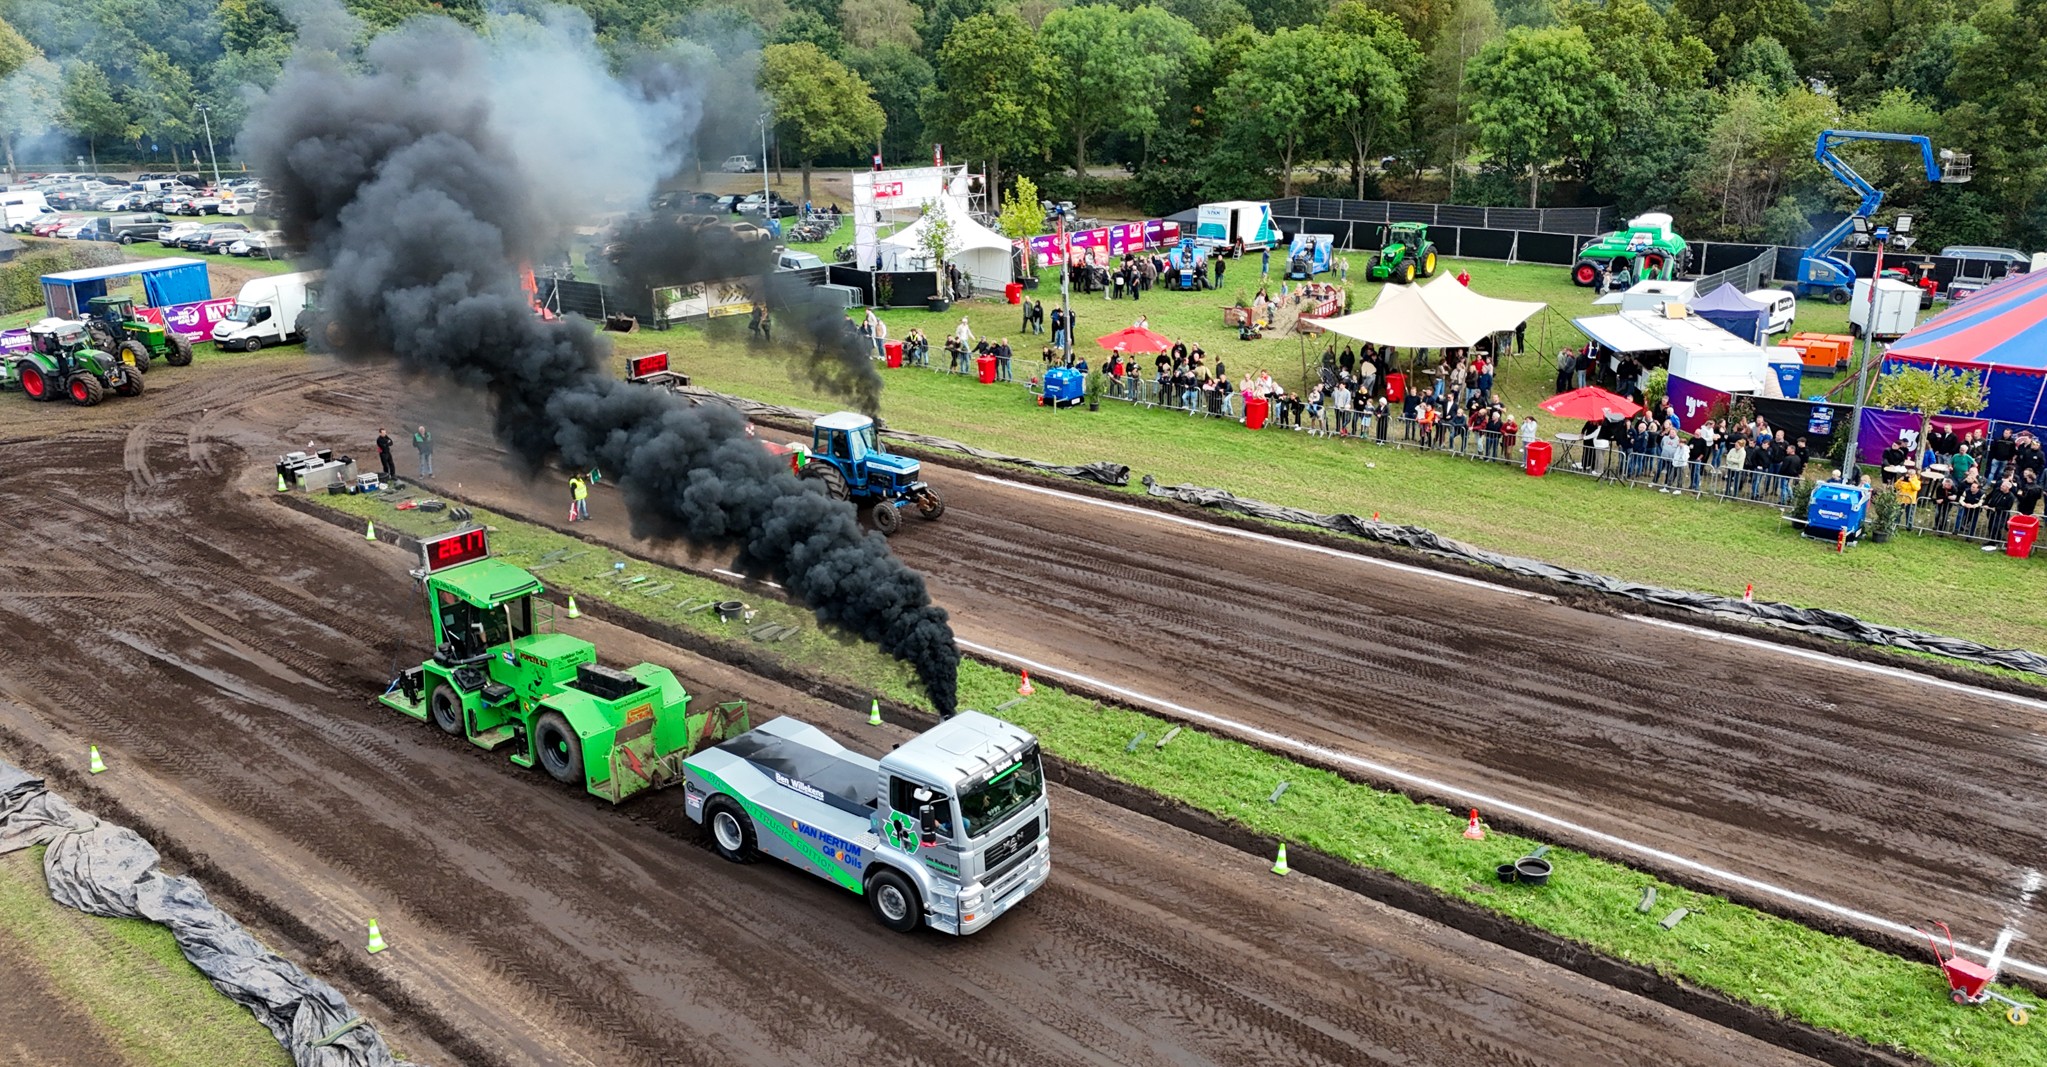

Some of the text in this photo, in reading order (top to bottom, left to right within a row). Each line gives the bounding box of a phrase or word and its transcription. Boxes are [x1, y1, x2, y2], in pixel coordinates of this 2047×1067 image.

[775, 772, 824, 799] Ben Willekens
[799, 824, 861, 857] VAN HERTUM
[796, 840, 835, 874] EDITION
[823, 845, 862, 869] Q8 Oils
